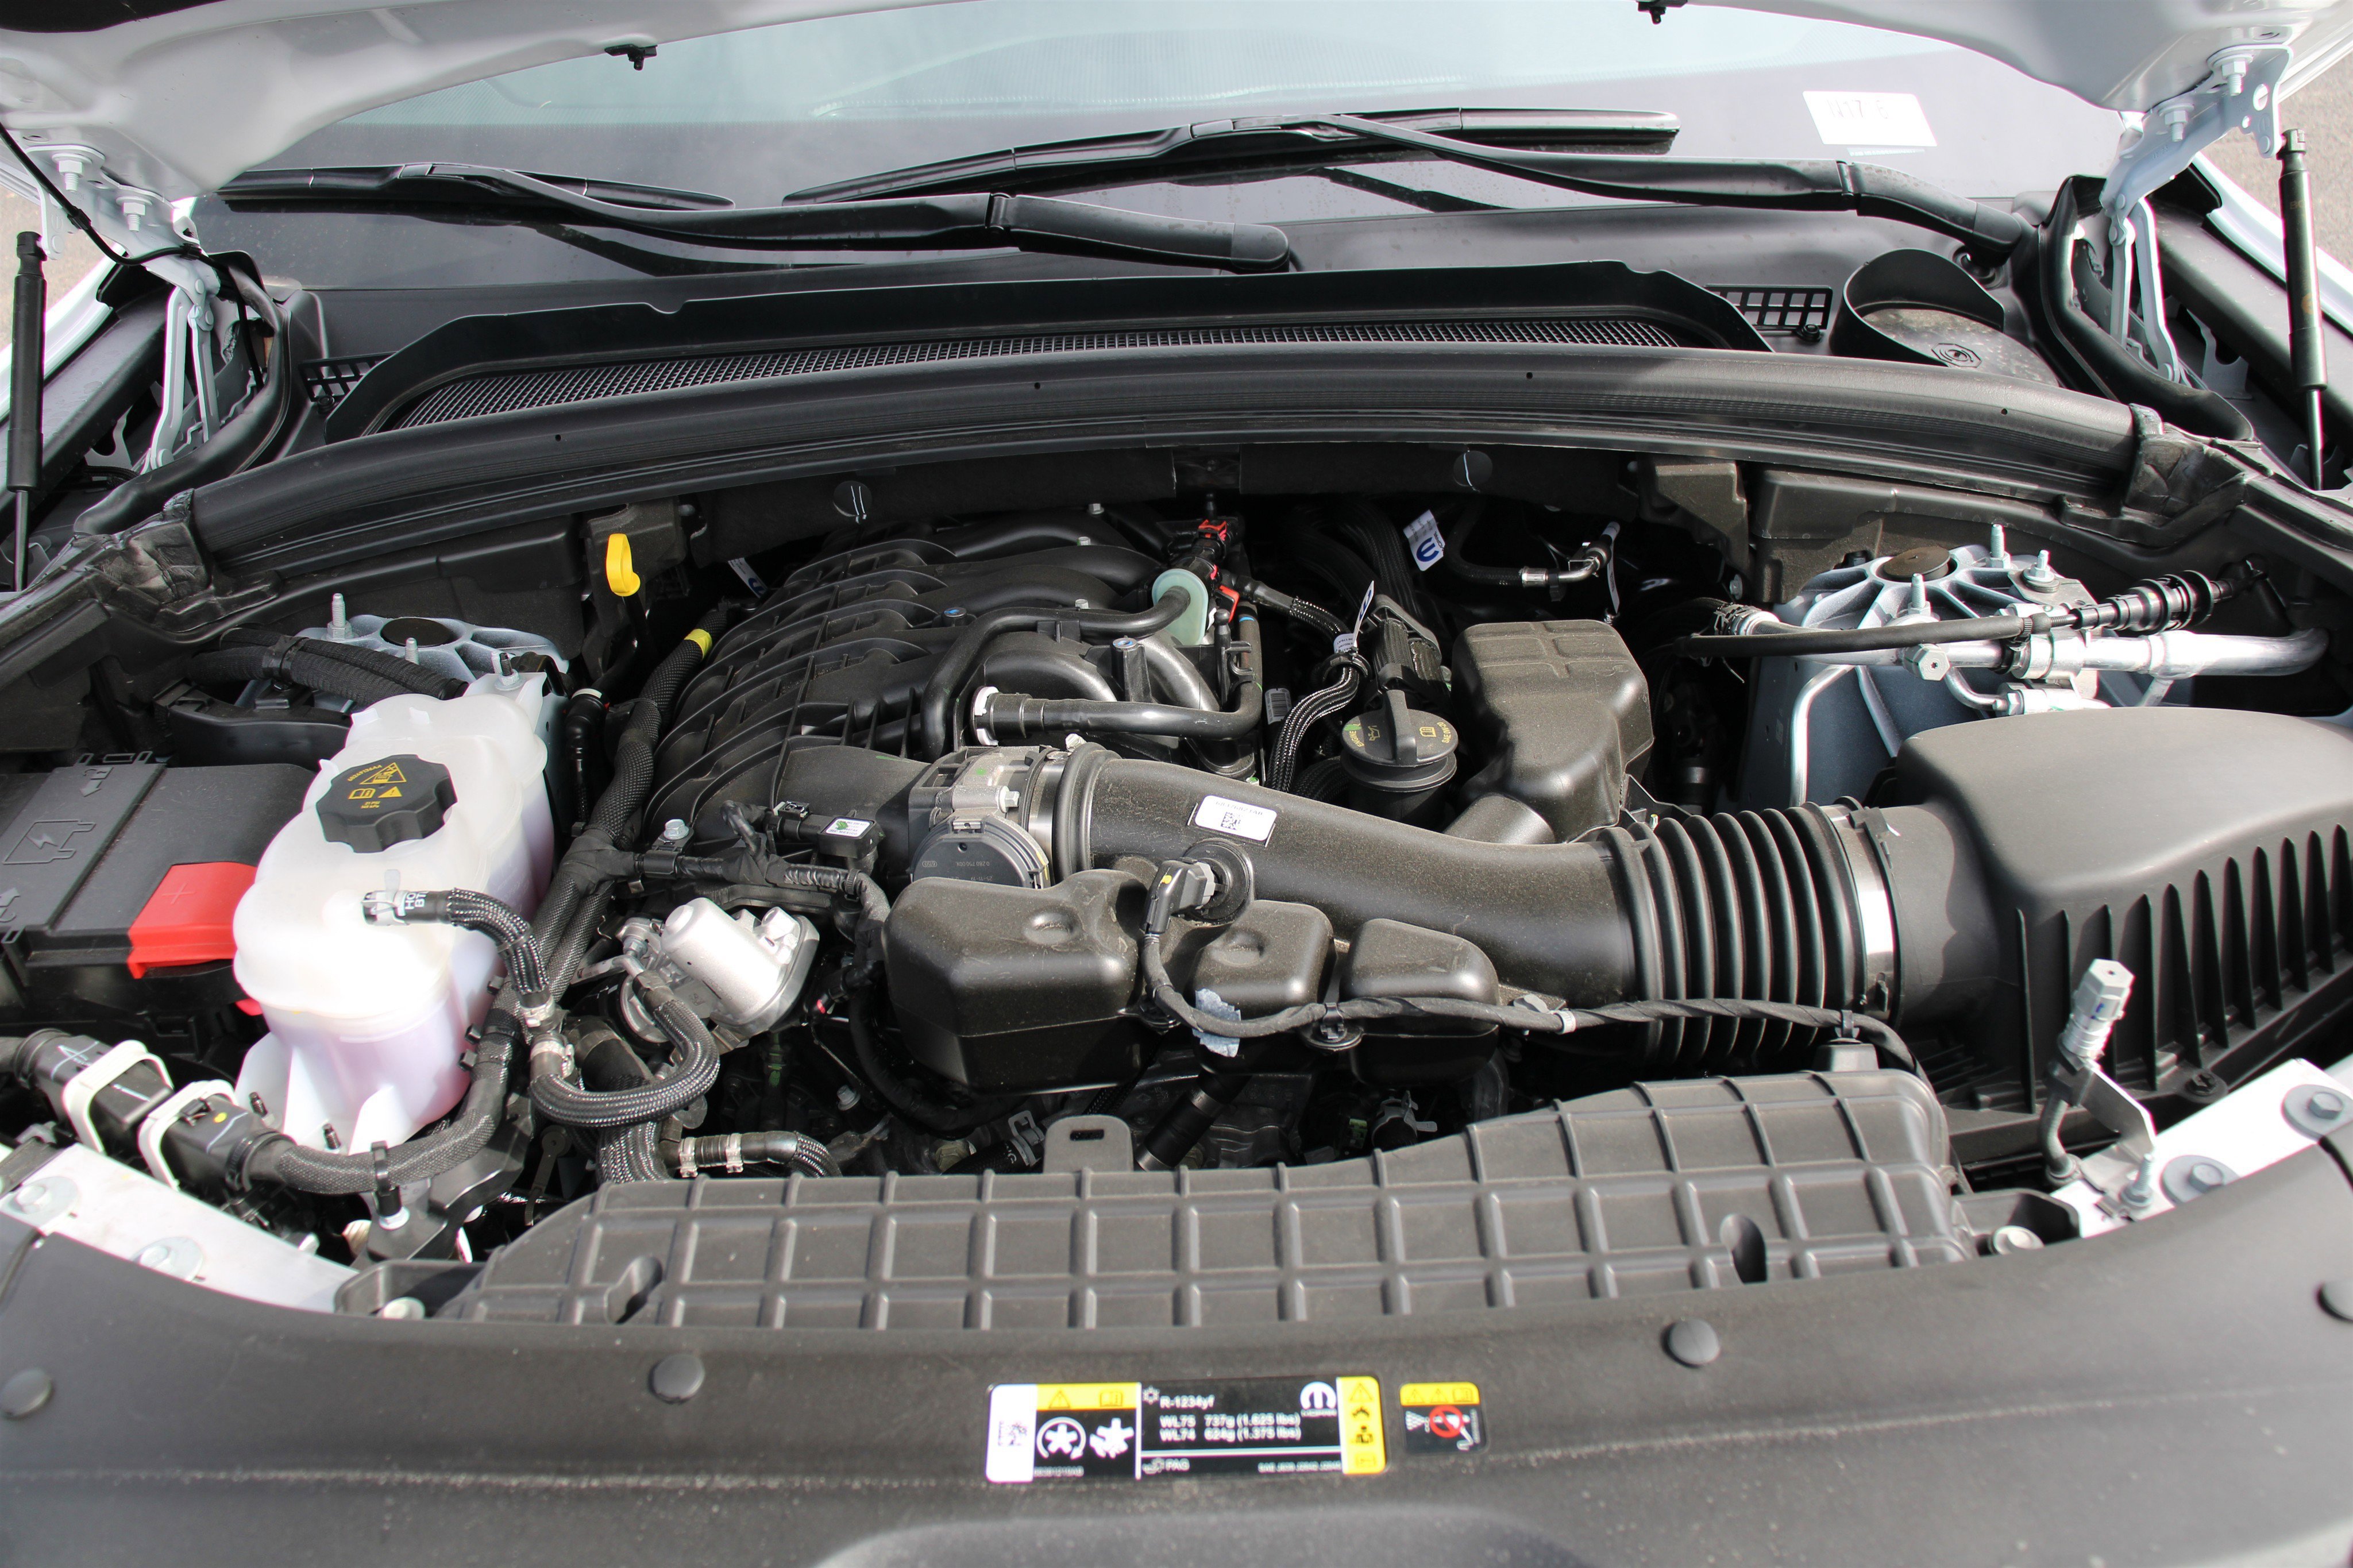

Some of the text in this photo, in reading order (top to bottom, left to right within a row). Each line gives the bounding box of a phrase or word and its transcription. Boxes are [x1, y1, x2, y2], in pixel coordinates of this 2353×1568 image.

[1349, 730, 1365, 747] ENGINE
[1437, 721, 1452, 744] SAE 0W-20
[1160, 1395, 1215, 1409] R-1234yf
[1159, 1414, 1196, 1428] WL75
[1204, 1413, 1235, 1428] 737g
[1276, 1412, 1301, 1427] lbs)
[1159, 1428, 1196, 1442] WL74
[1204, 1427, 1235, 1443] 624g
[1276, 1425, 1302, 1441] lbs)
[1165, 1457, 1190, 1472] PAG
